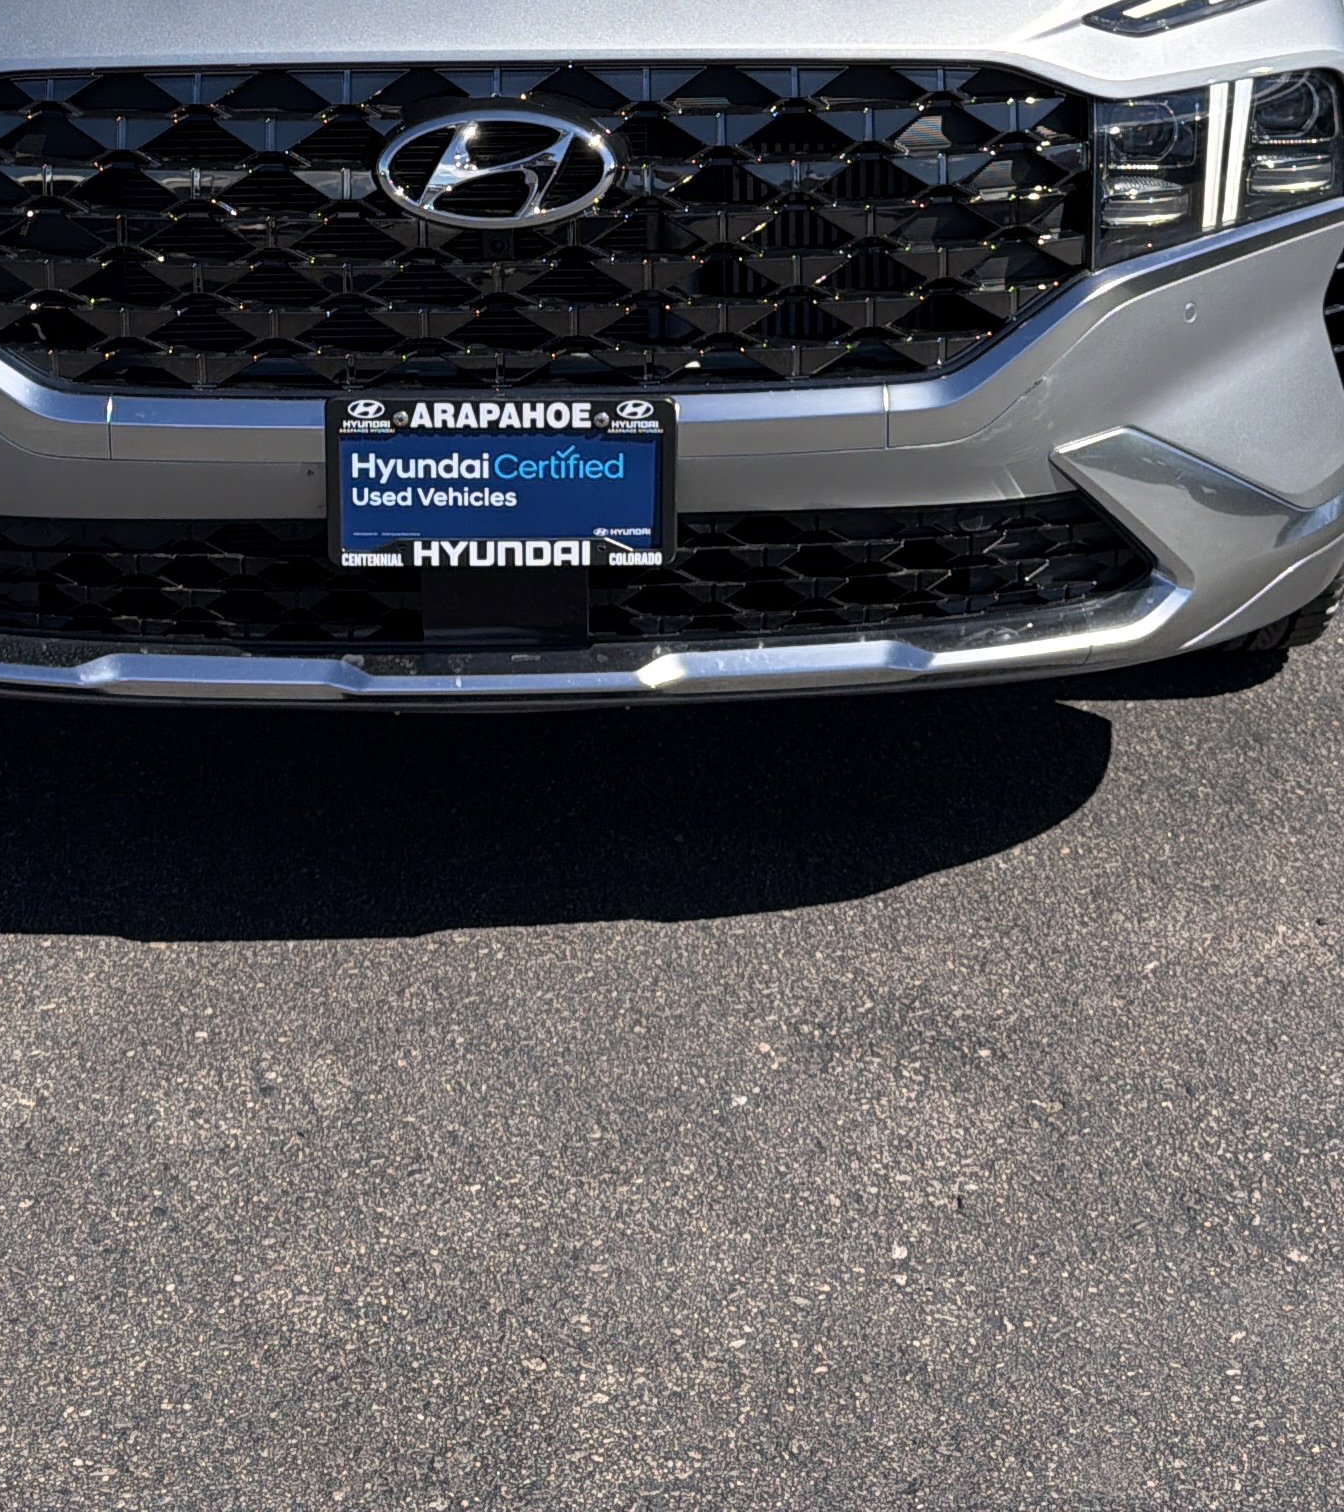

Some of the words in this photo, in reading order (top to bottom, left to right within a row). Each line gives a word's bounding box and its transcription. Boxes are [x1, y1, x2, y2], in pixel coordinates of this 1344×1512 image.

[410, 402, 592, 429] ARAPAHOE
[342, 420, 391, 428] HYUNDAI
[611, 420, 659, 428] HYUNDAI
[351, 452, 490, 484] Hyundai
[494, 445, 625, 480] Certified
[351, 487, 412, 507] Used
[416, 487, 518, 507] Vehicles
[609, 527, 652, 536] HYUNDAI
[341, 553, 404, 567] CENTENNIAL
[413, 540, 591, 567] HYUNDAI
[608, 552, 663, 566] COLORADO
